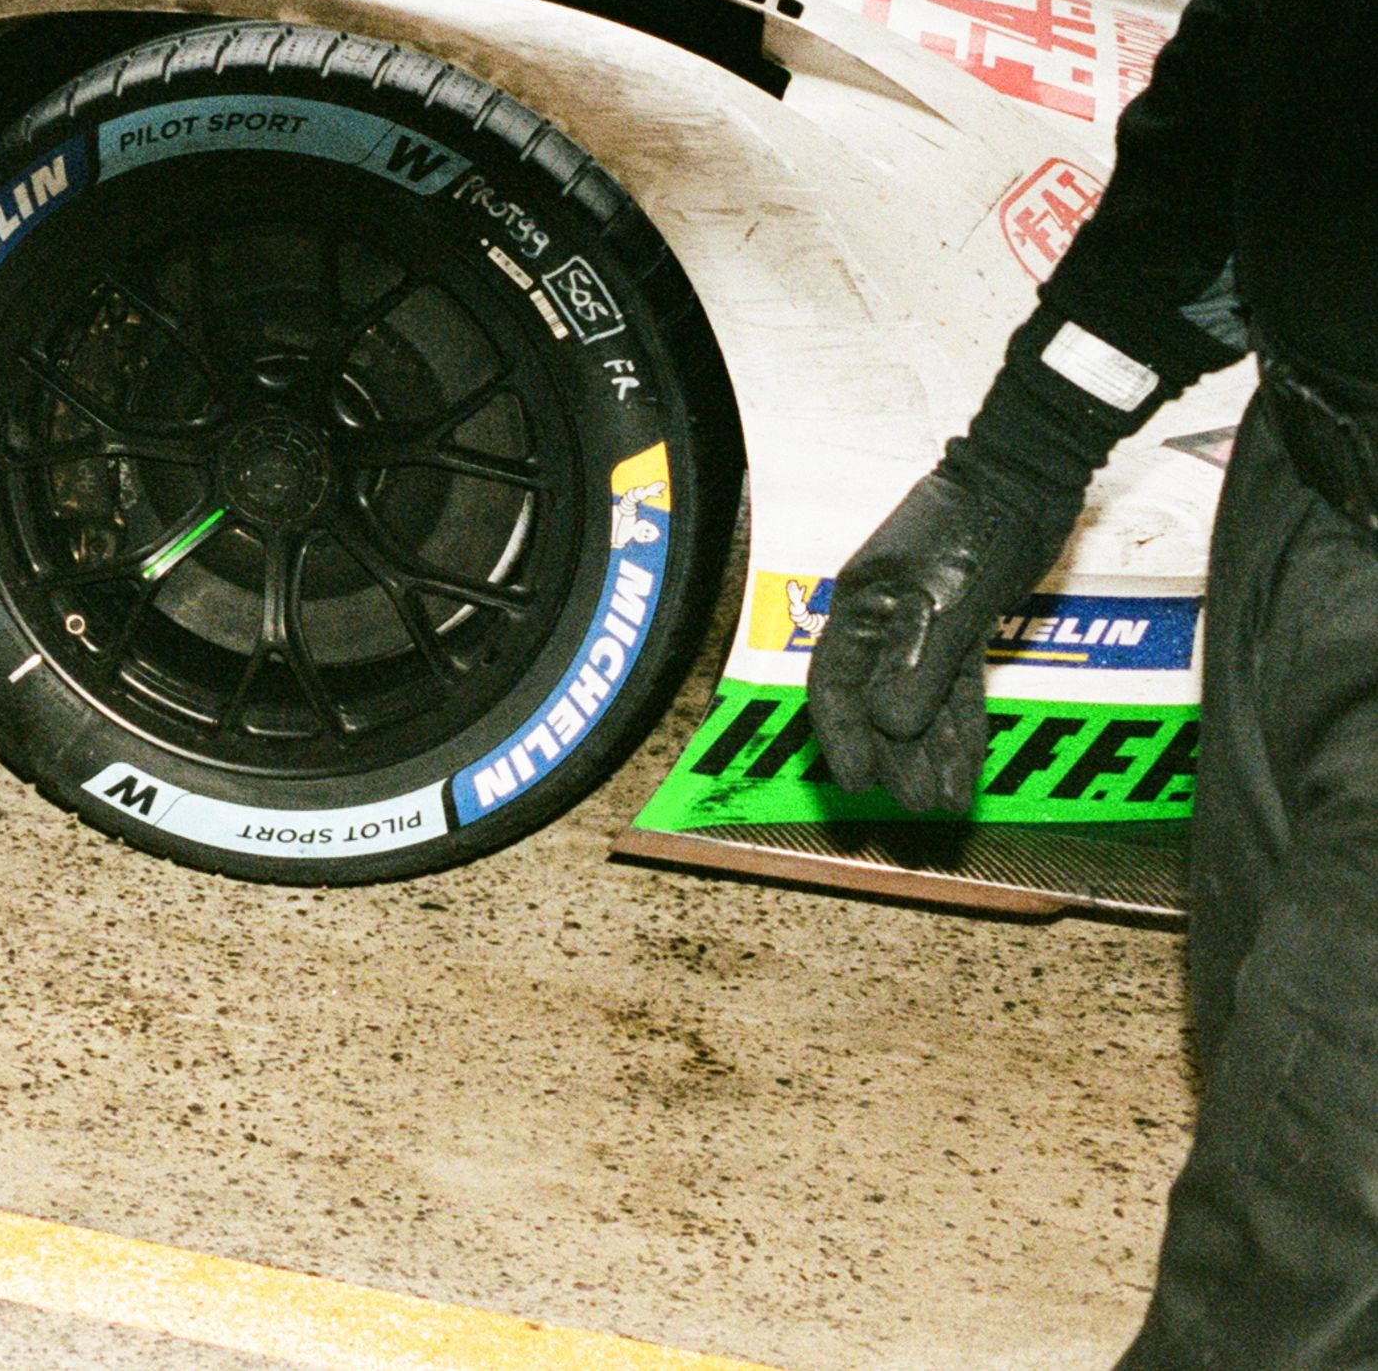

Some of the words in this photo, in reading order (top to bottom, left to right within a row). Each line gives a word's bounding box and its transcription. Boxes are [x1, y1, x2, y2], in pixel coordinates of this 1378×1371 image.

[118, 115, 201, 150] PILOT
[206, 111, 308, 136] SPORT
[987, 614, 1150, 646] HELIN
[473, 557, 654, 809] MICHELIN
[236, 821, 334, 845] SPORT
[338, 809, 422, 843] PILOT
